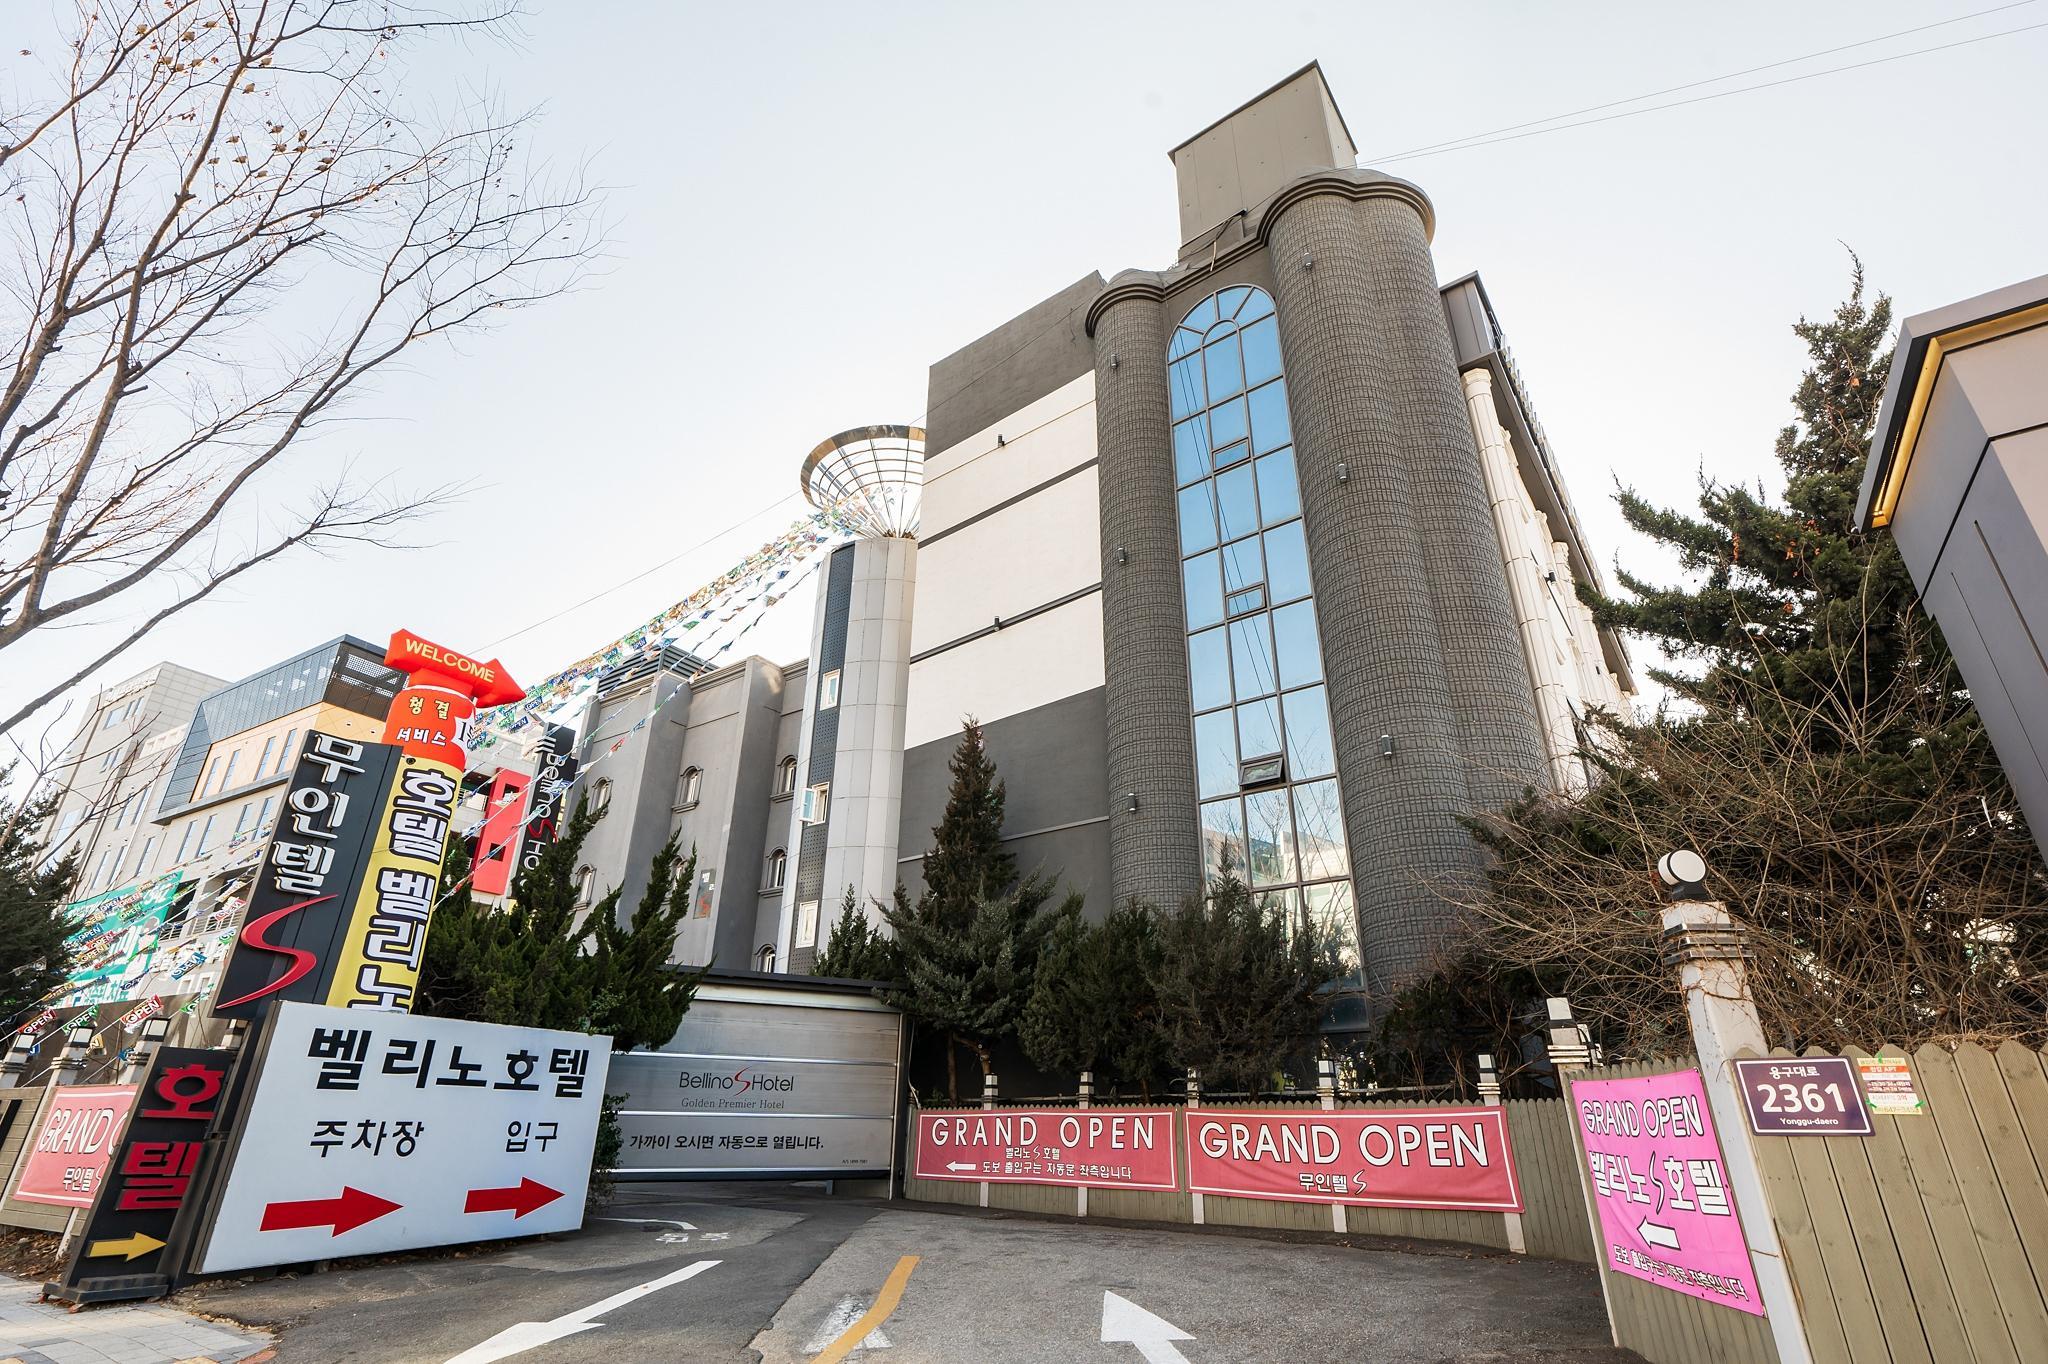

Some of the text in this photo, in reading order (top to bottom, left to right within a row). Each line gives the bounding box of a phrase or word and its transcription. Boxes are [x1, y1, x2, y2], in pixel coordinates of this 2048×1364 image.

[405, 638, 496, 684] WELCOME
[272, 733, 366, 895] 무인텔
[349, 768, 456, 1014] 호텔 벨리노
[24, 1012, 54, 1034] OPEN
[126, 998, 160, 1024] OPEN
[307, 1027, 590, 1099] 벨리노호텔
[1769, 1066, 1820, 1080] 용구대로
[678, 1071, 734, 1092] Bellino
[751, 1074, 795, 1092] Hotel
[1756, 1082, 1846, 1113] 2361
[681, 1097, 785, 1110] Golden Premier Hotel
[1581, 1094, 1705, 1138] GRAND OPEN
[38, 1107, 115, 1155] GRAND
[116, 1063, 227, 1211] 호텔
[309, 1119, 425, 1159] 주차장
[505, 1120, 560, 1154] 입구
[931, 1116, 1155, 1150] GRAND OPEN
[1780, 1117, 1839, 1127] Yonggu-daero
[629, 1134, 824, 1150] 가까이 오시면 자동으로 열립니다.
[1005, 1147, 1031, 1159] 벨리노
[1042, 1147, 1060, 1161] 호텔
[1199, 1120, 1489, 1168] GRAND OPEN
[983, 1161, 1132, 1180] 도보 출입구는 자동문 좌측입니다
[1299, 1172, 1349, 1194] 무인텔
[1662, 1155, 1732, 1217] 호텔
